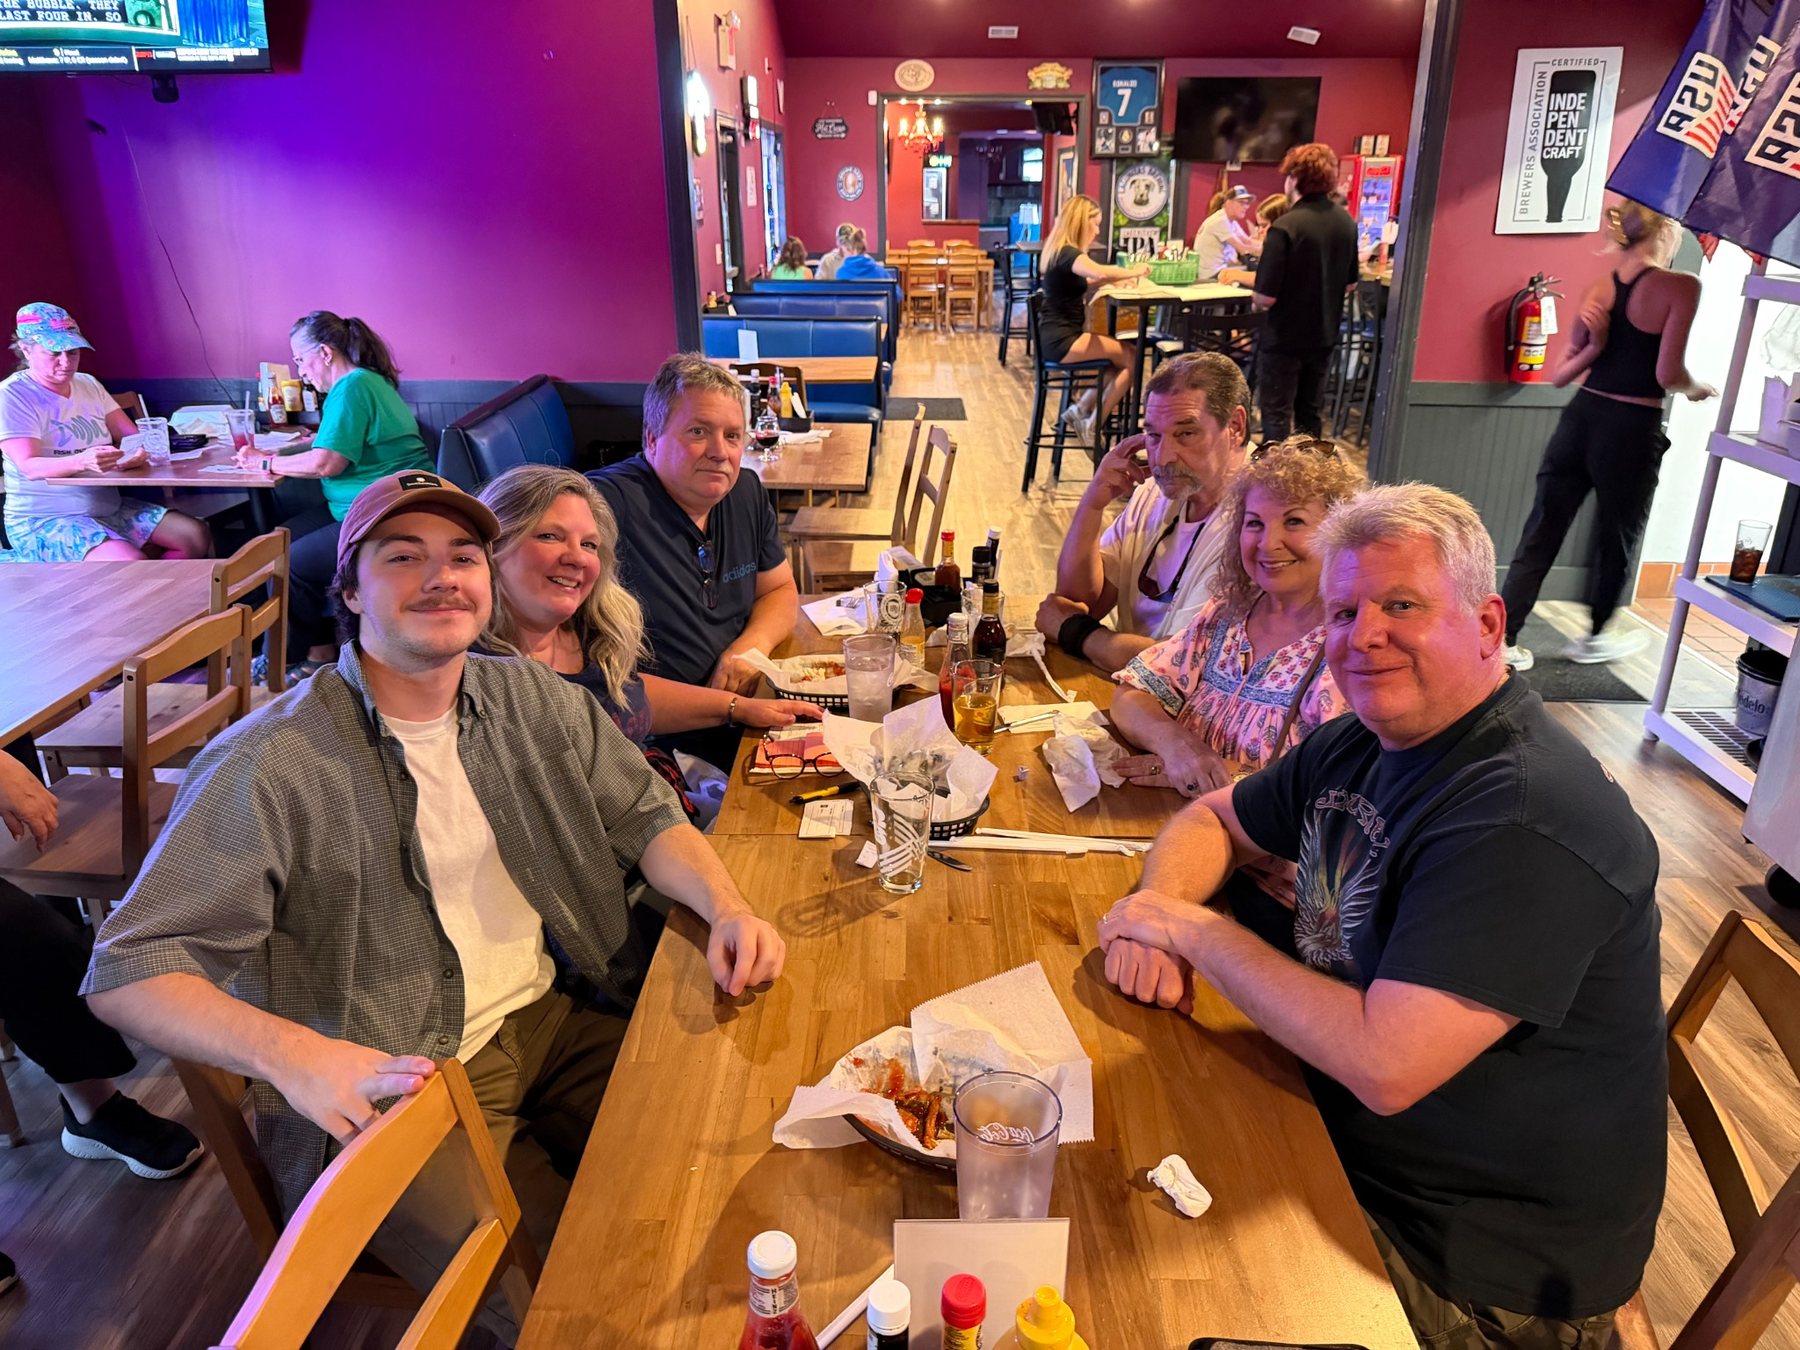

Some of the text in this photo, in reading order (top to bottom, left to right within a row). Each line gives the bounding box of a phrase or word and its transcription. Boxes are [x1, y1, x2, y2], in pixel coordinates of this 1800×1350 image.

[88, 0, 119, 11] THEY
[36, 11, 70, 21] FOUR
[105, 12, 122, 22] SO
[1551, 58, 1599, 67] CERTIFIED
[1117, 88, 1132, 117] 7
[1548, 92, 1588, 111] INDE
[1546, 111, 1580, 129] PEN
[1519, 71, 1547, 215] BREWERS ASSOCIATION
[1544, 128, 1588, 147] DENT
[1542, 147, 1582, 159] CRAFT
[722, 561, 757, 584] adidas
